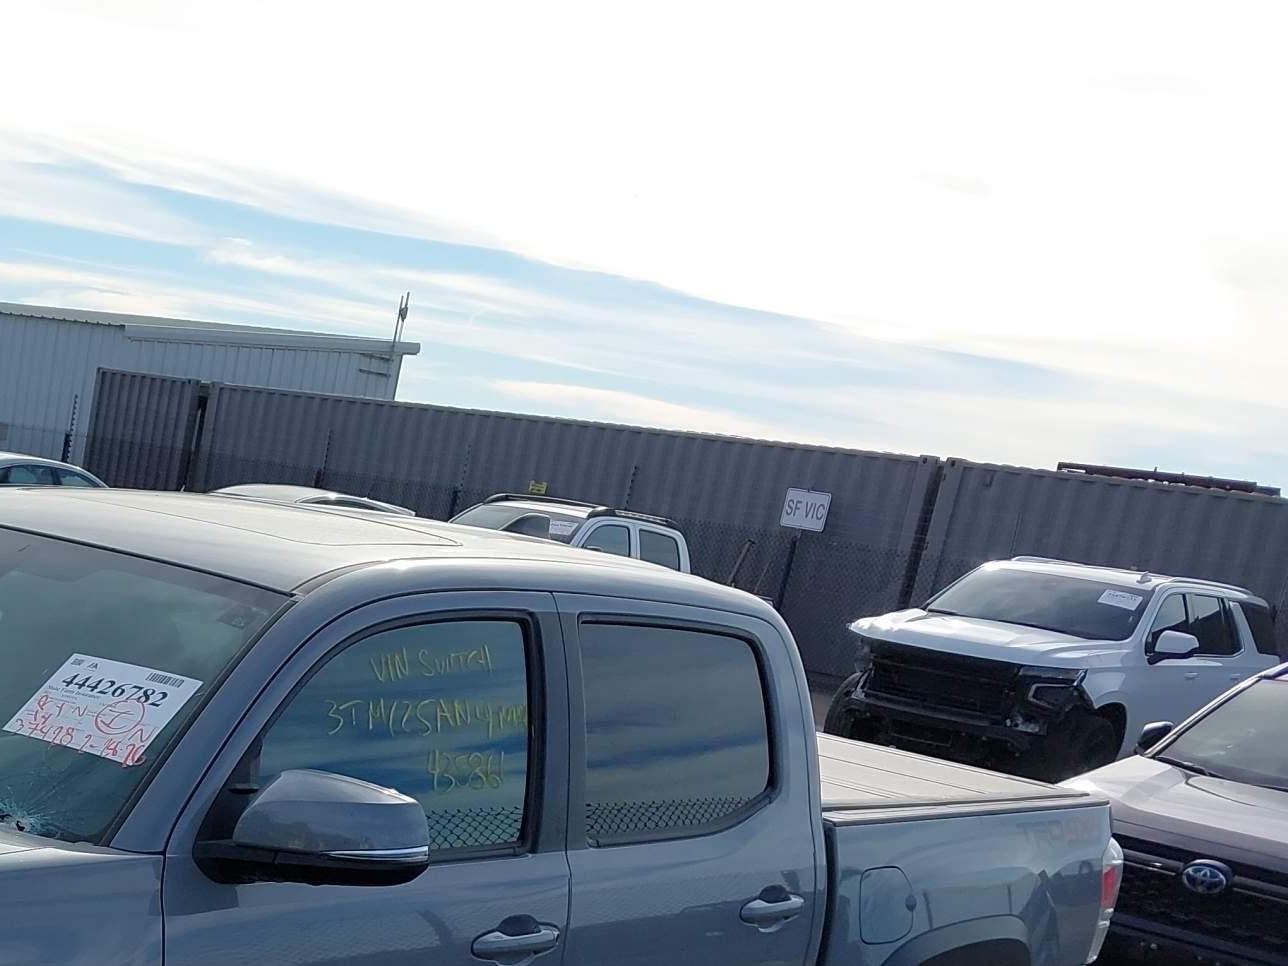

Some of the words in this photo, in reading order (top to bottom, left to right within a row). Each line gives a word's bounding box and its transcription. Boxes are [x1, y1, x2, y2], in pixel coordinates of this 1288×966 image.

[785, 499, 802, 517] SF
[805, 501, 826, 520] VIC
[369, 647, 409, 682] VIN
[62, 673, 168, 708] 44426782
